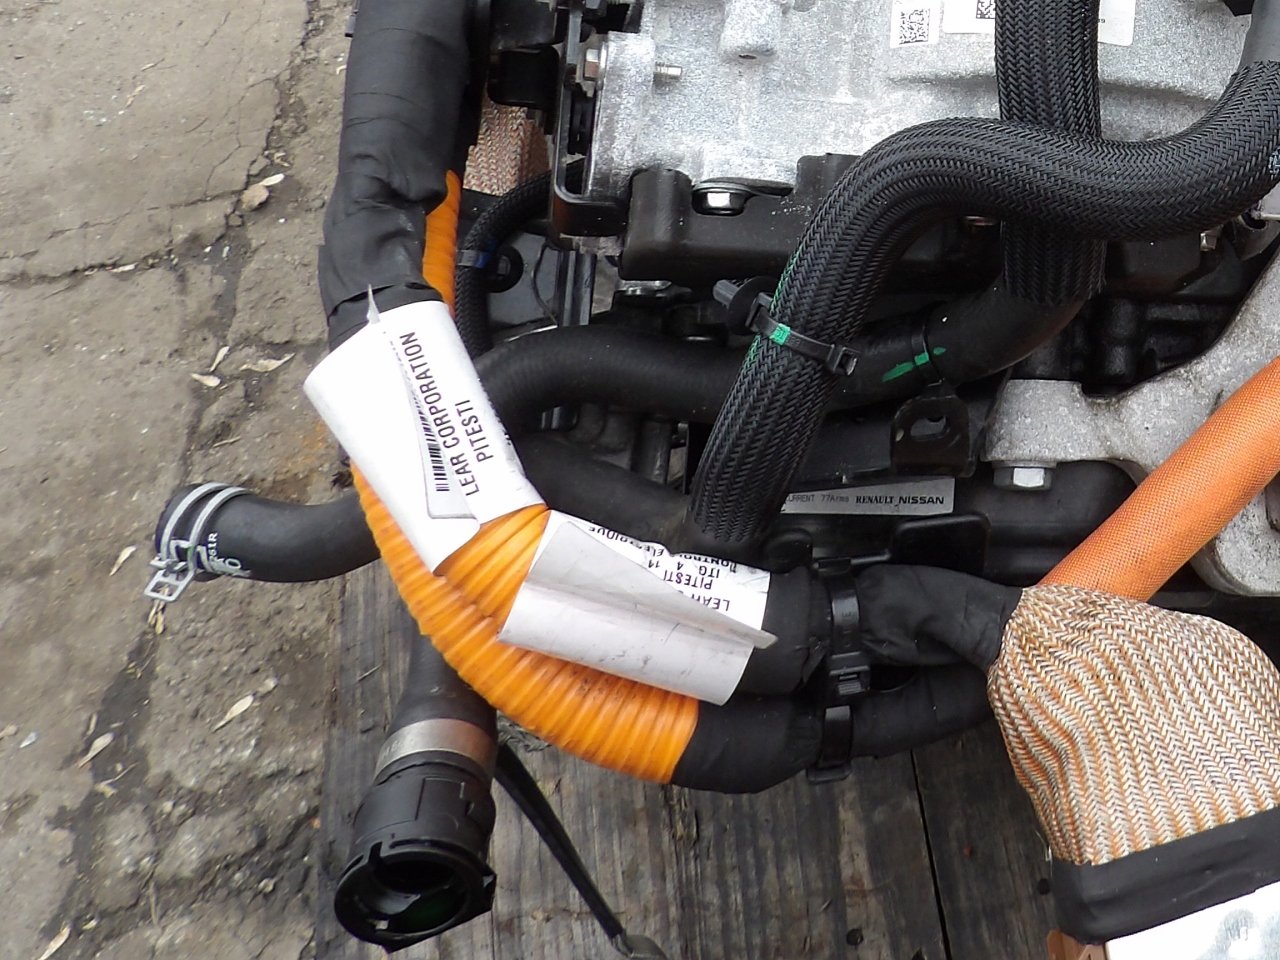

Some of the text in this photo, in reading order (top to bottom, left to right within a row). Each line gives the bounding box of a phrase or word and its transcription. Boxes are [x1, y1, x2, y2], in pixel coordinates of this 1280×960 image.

[399, 332, 480, 496] LEAR CORPORATION
[455, 400, 494, 462] PITESTI
[855, 495, 945, 505] RENAULT NISSAN
[676, 561, 684, 571] 4
[698, 565, 720, 579] ITG
[663, 569, 713, 590] PITESTI
